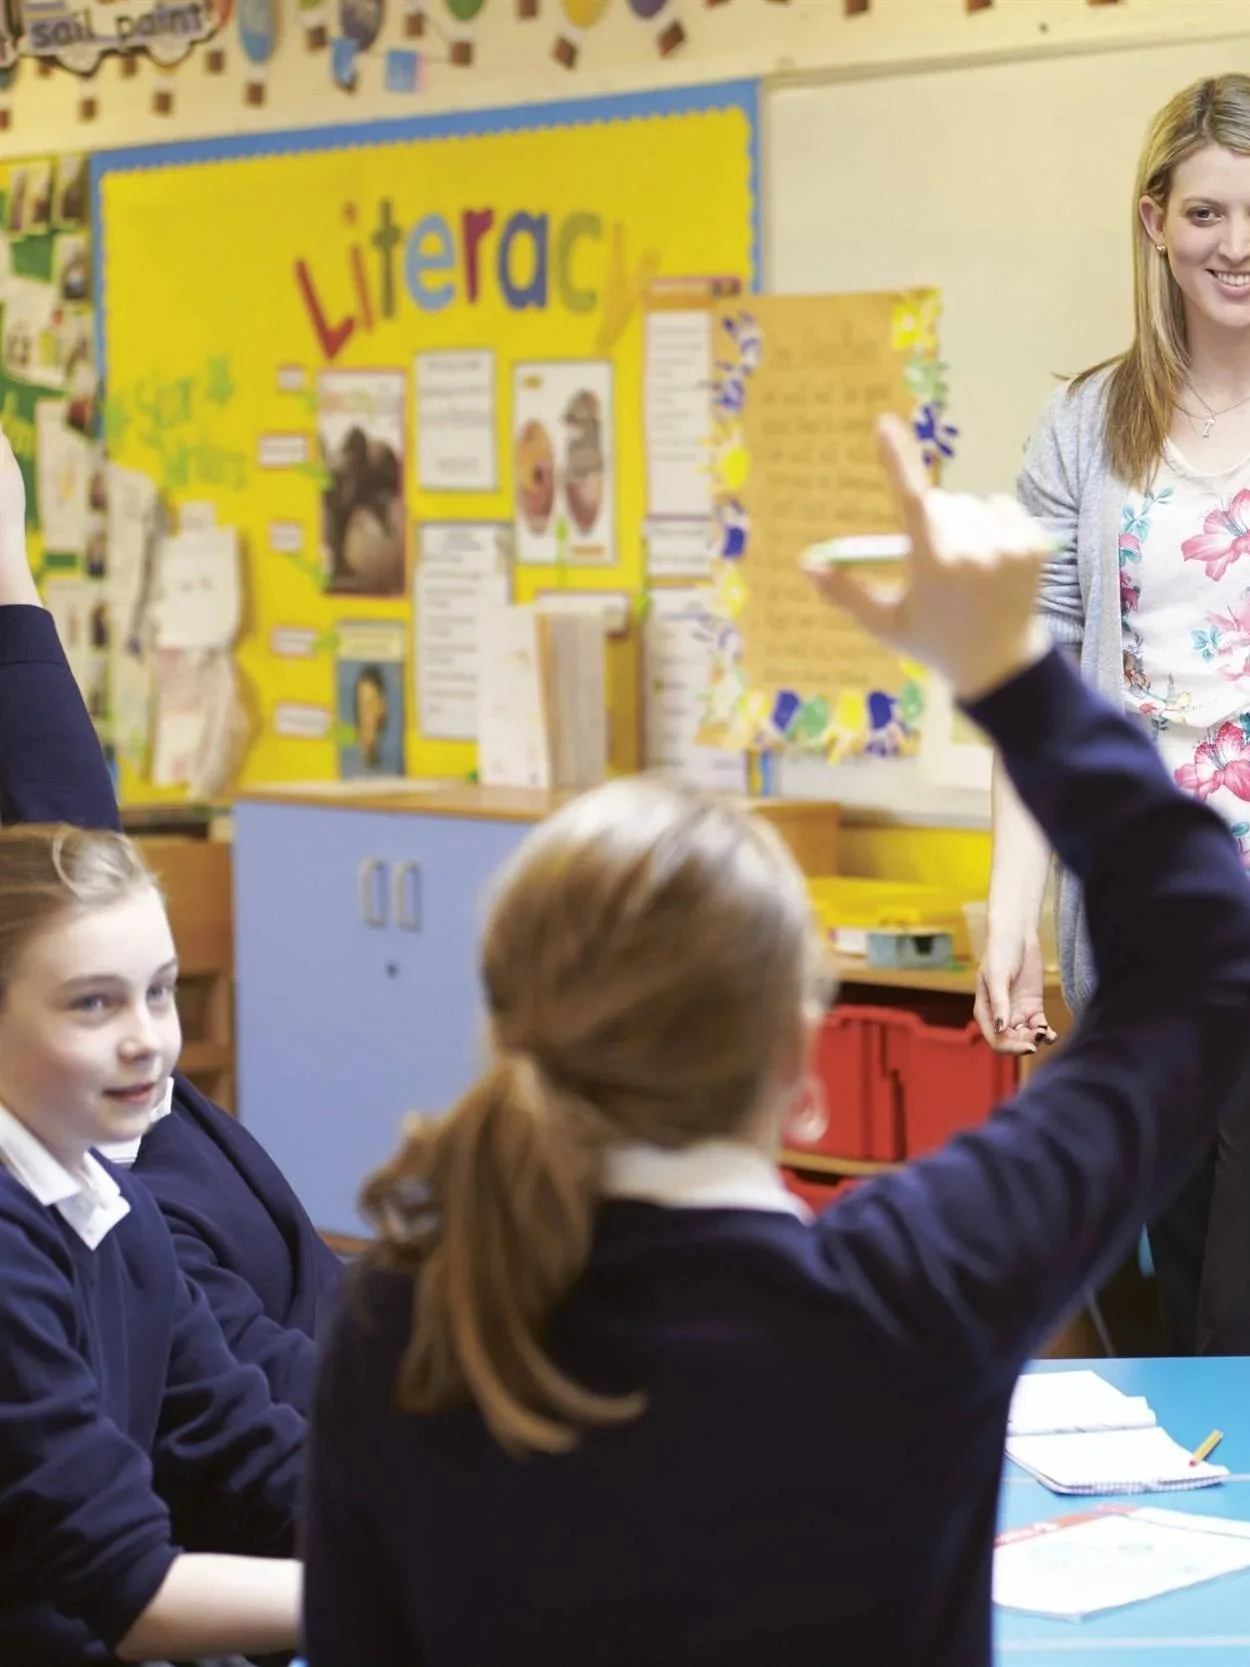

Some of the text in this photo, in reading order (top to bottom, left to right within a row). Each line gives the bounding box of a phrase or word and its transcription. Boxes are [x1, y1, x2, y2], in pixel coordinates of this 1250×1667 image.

[30, 3, 202, 51] sail paint
[295, 197, 659, 364] Literacy
